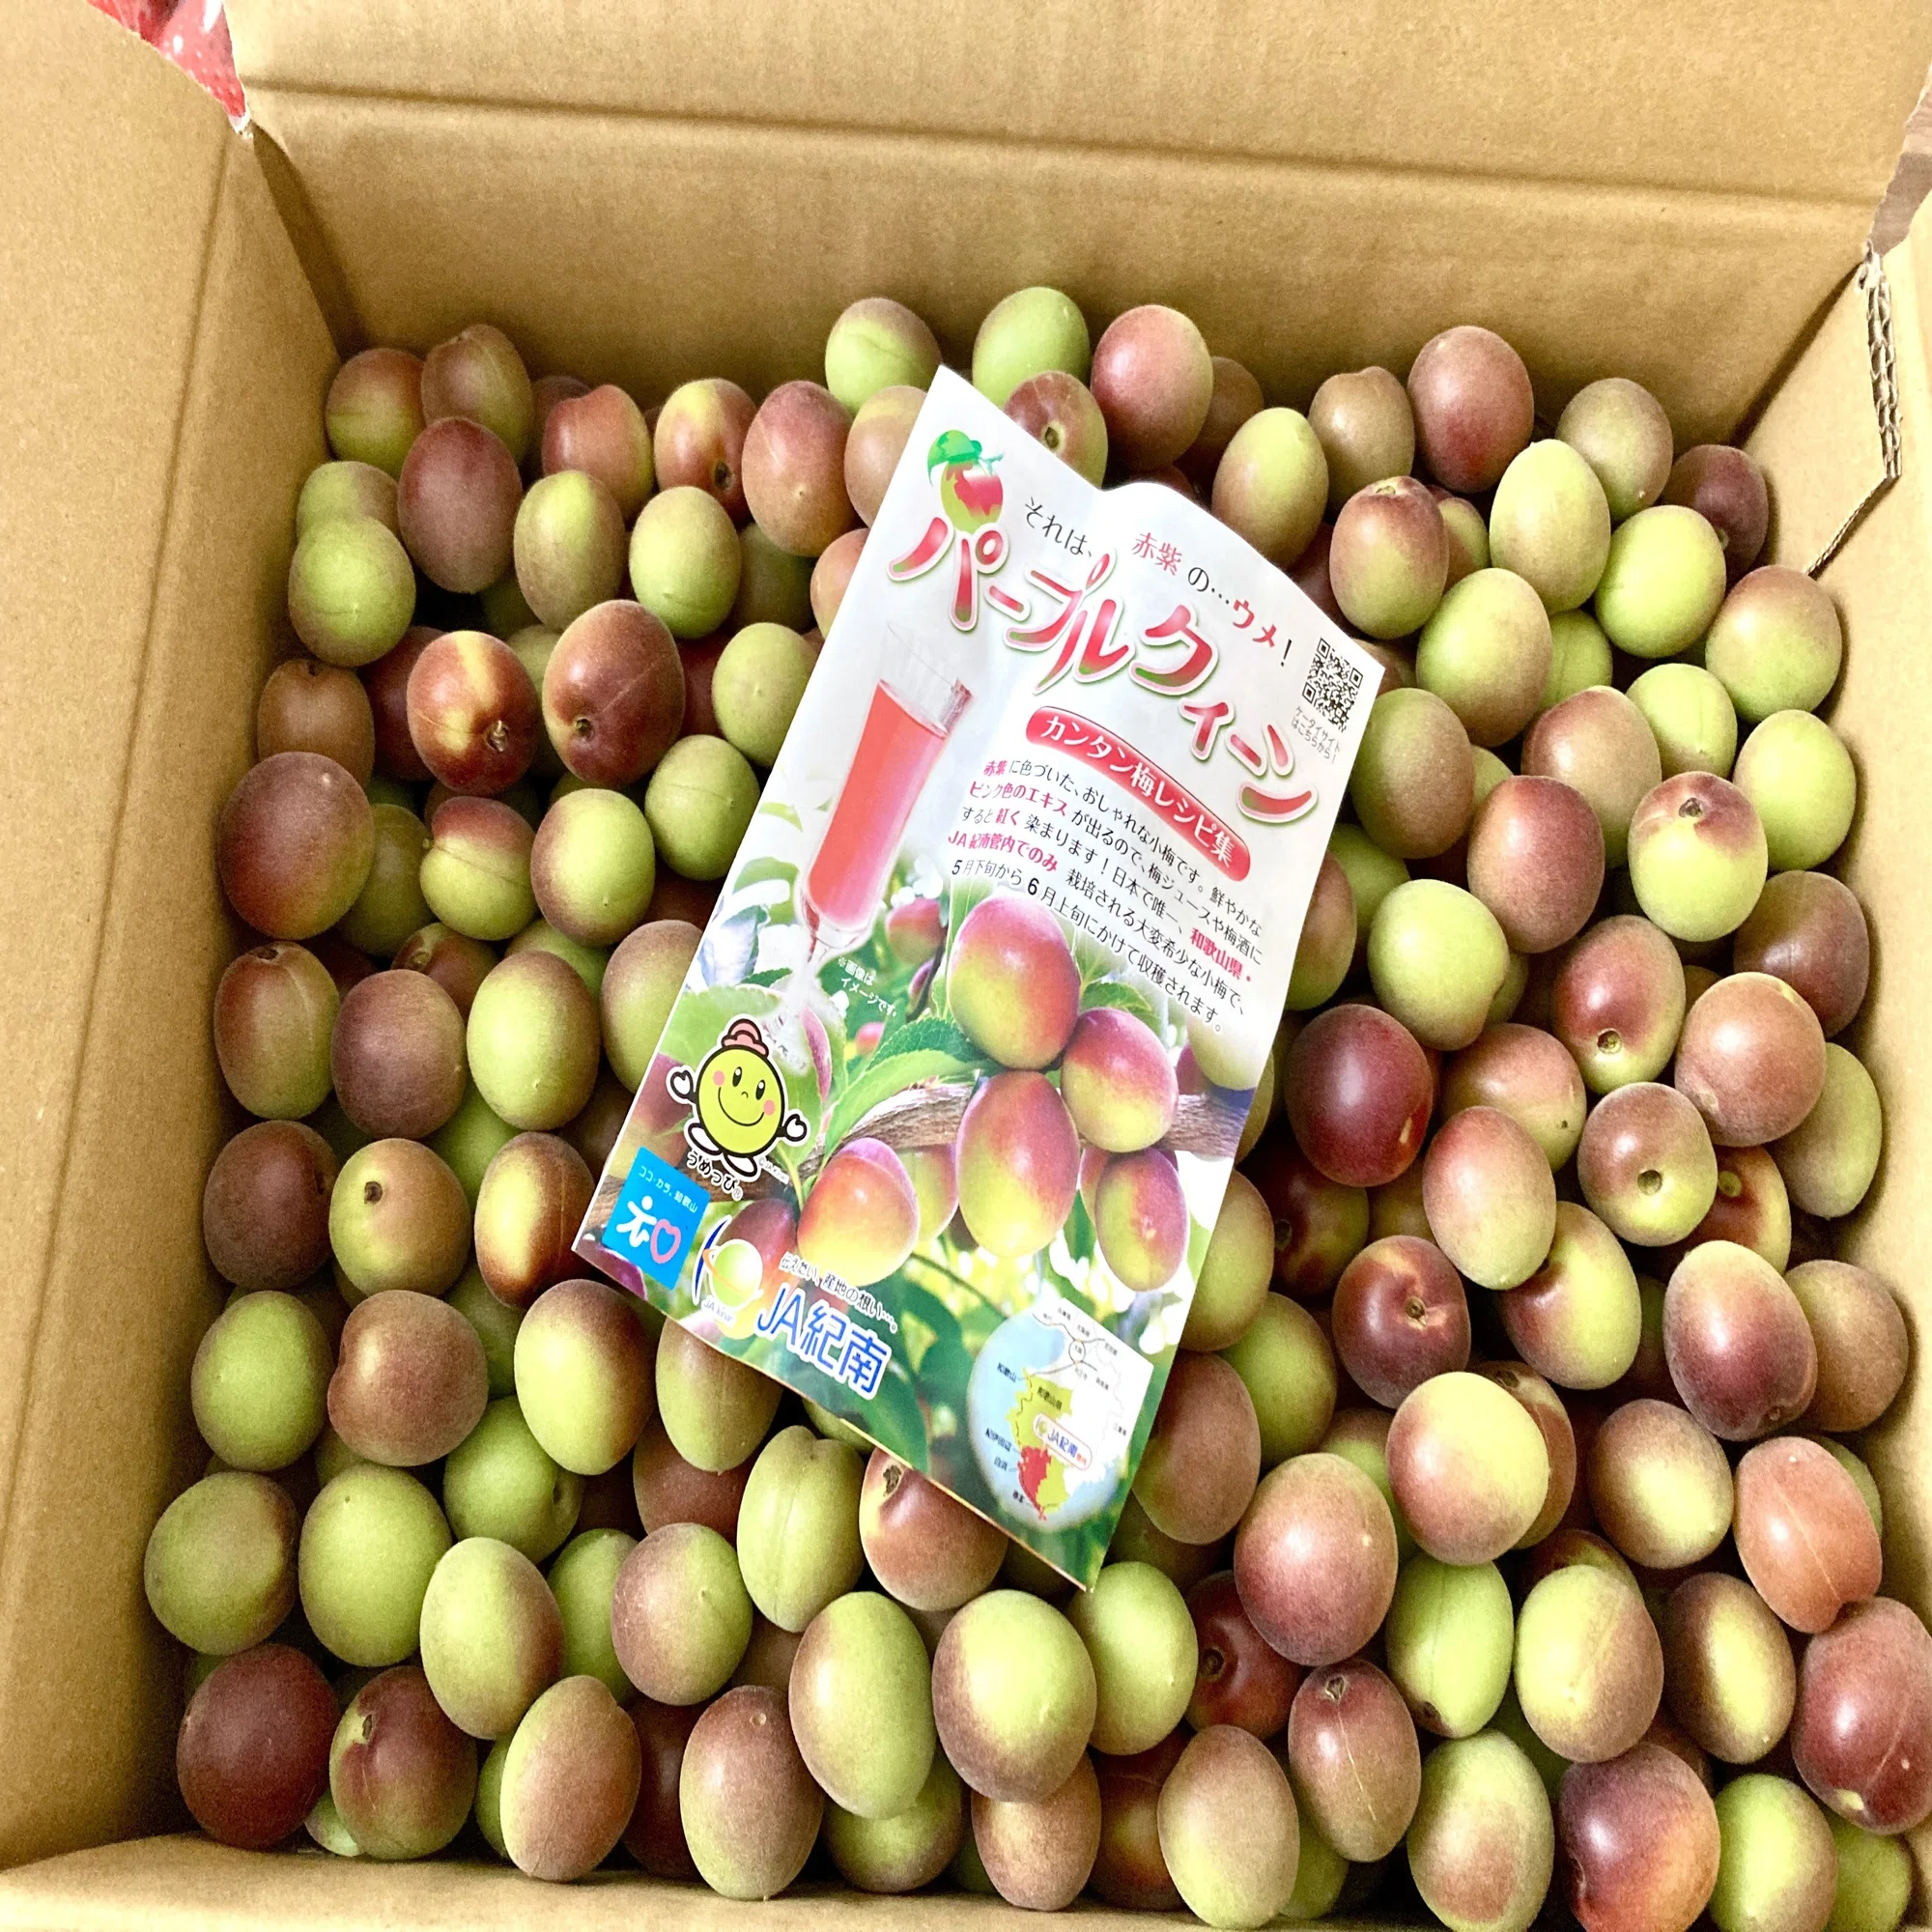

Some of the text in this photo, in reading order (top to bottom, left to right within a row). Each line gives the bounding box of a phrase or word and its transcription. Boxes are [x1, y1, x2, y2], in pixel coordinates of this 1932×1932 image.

[1295, 706, 1341, 753] ケータイサイト
[1040, 715, 1236, 868] カンタン梅レシピ集
[757, 1288, 888, 1393] JA紀南
